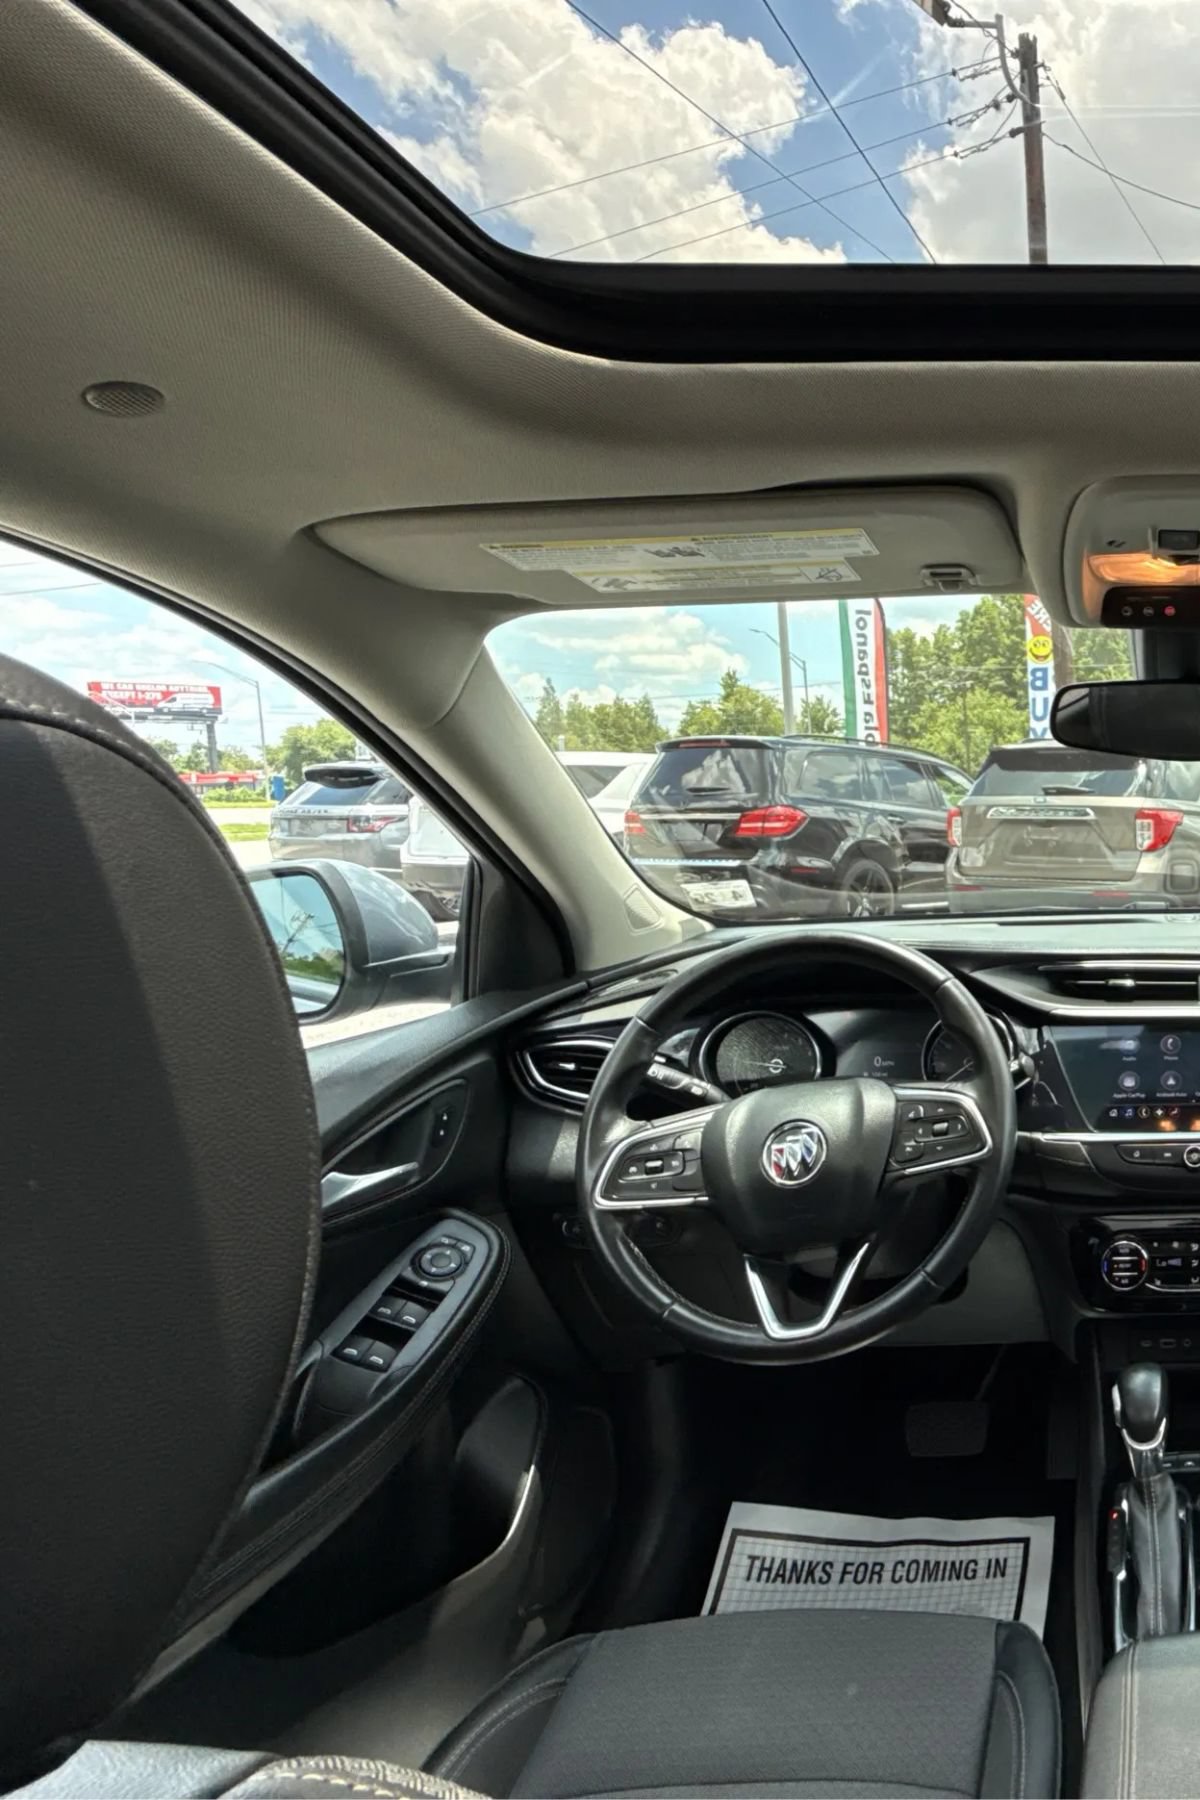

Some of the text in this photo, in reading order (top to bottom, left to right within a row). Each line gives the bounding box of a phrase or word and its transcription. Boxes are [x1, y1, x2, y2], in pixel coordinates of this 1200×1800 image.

[745, 1554, 1008, 1585] THANKS FOR COMING IN
